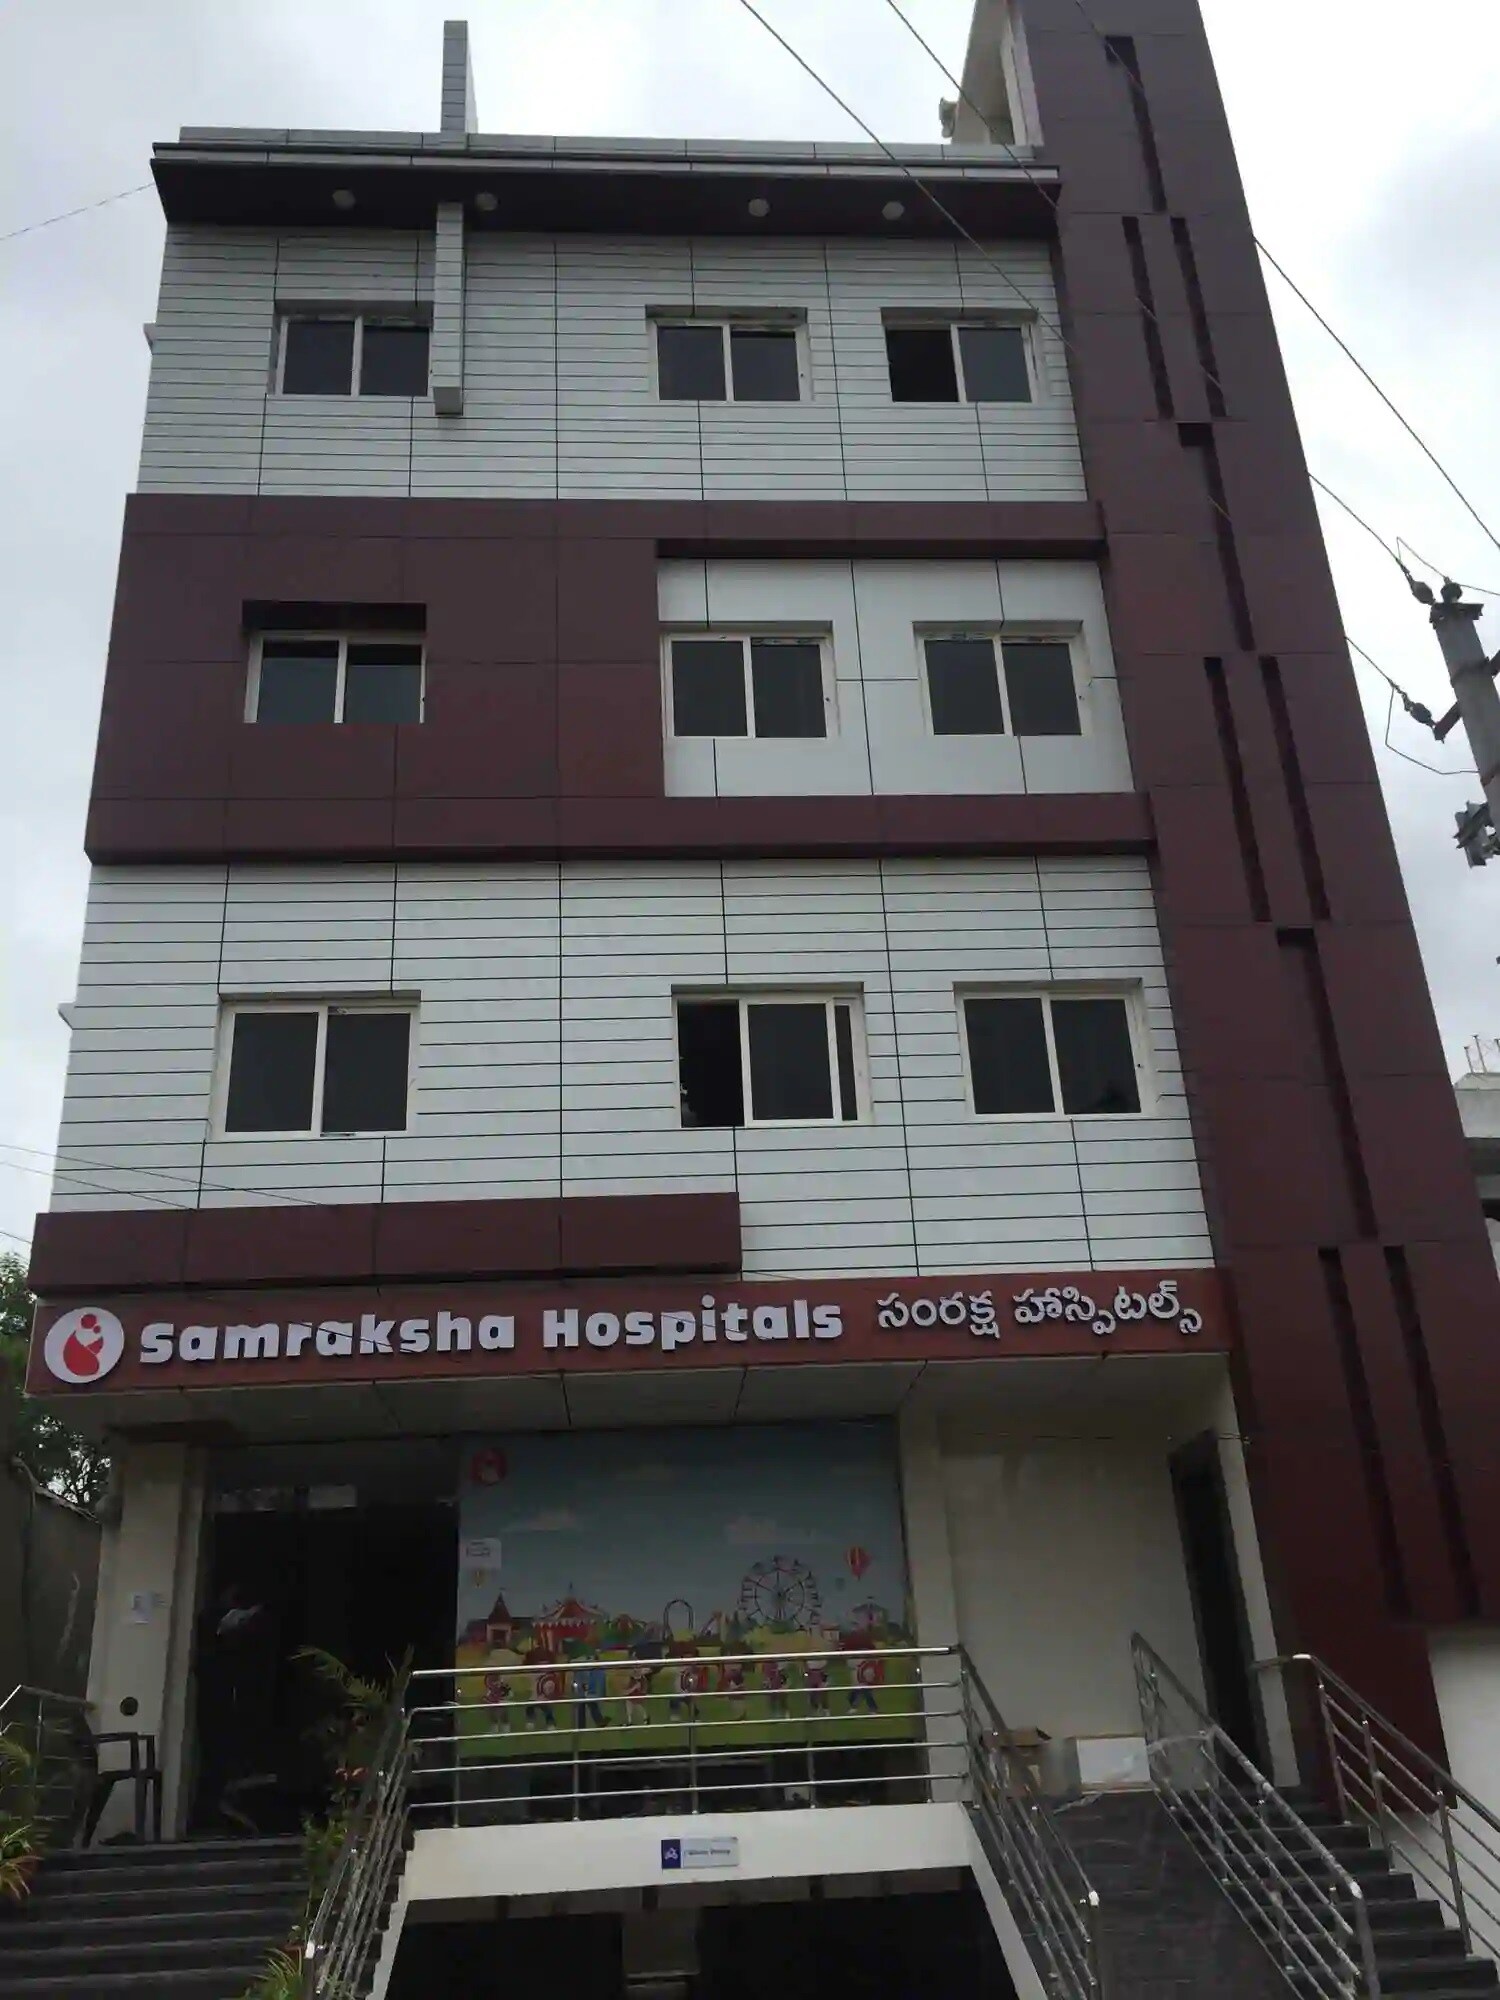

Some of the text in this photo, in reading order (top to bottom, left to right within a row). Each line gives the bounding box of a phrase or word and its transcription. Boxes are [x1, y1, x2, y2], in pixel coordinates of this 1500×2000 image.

[139, 1294, 844, 1364] Samraksha Hospitals
[877, 1280, 1202, 1339] సంరక్ష హాస్పిటల్స్
